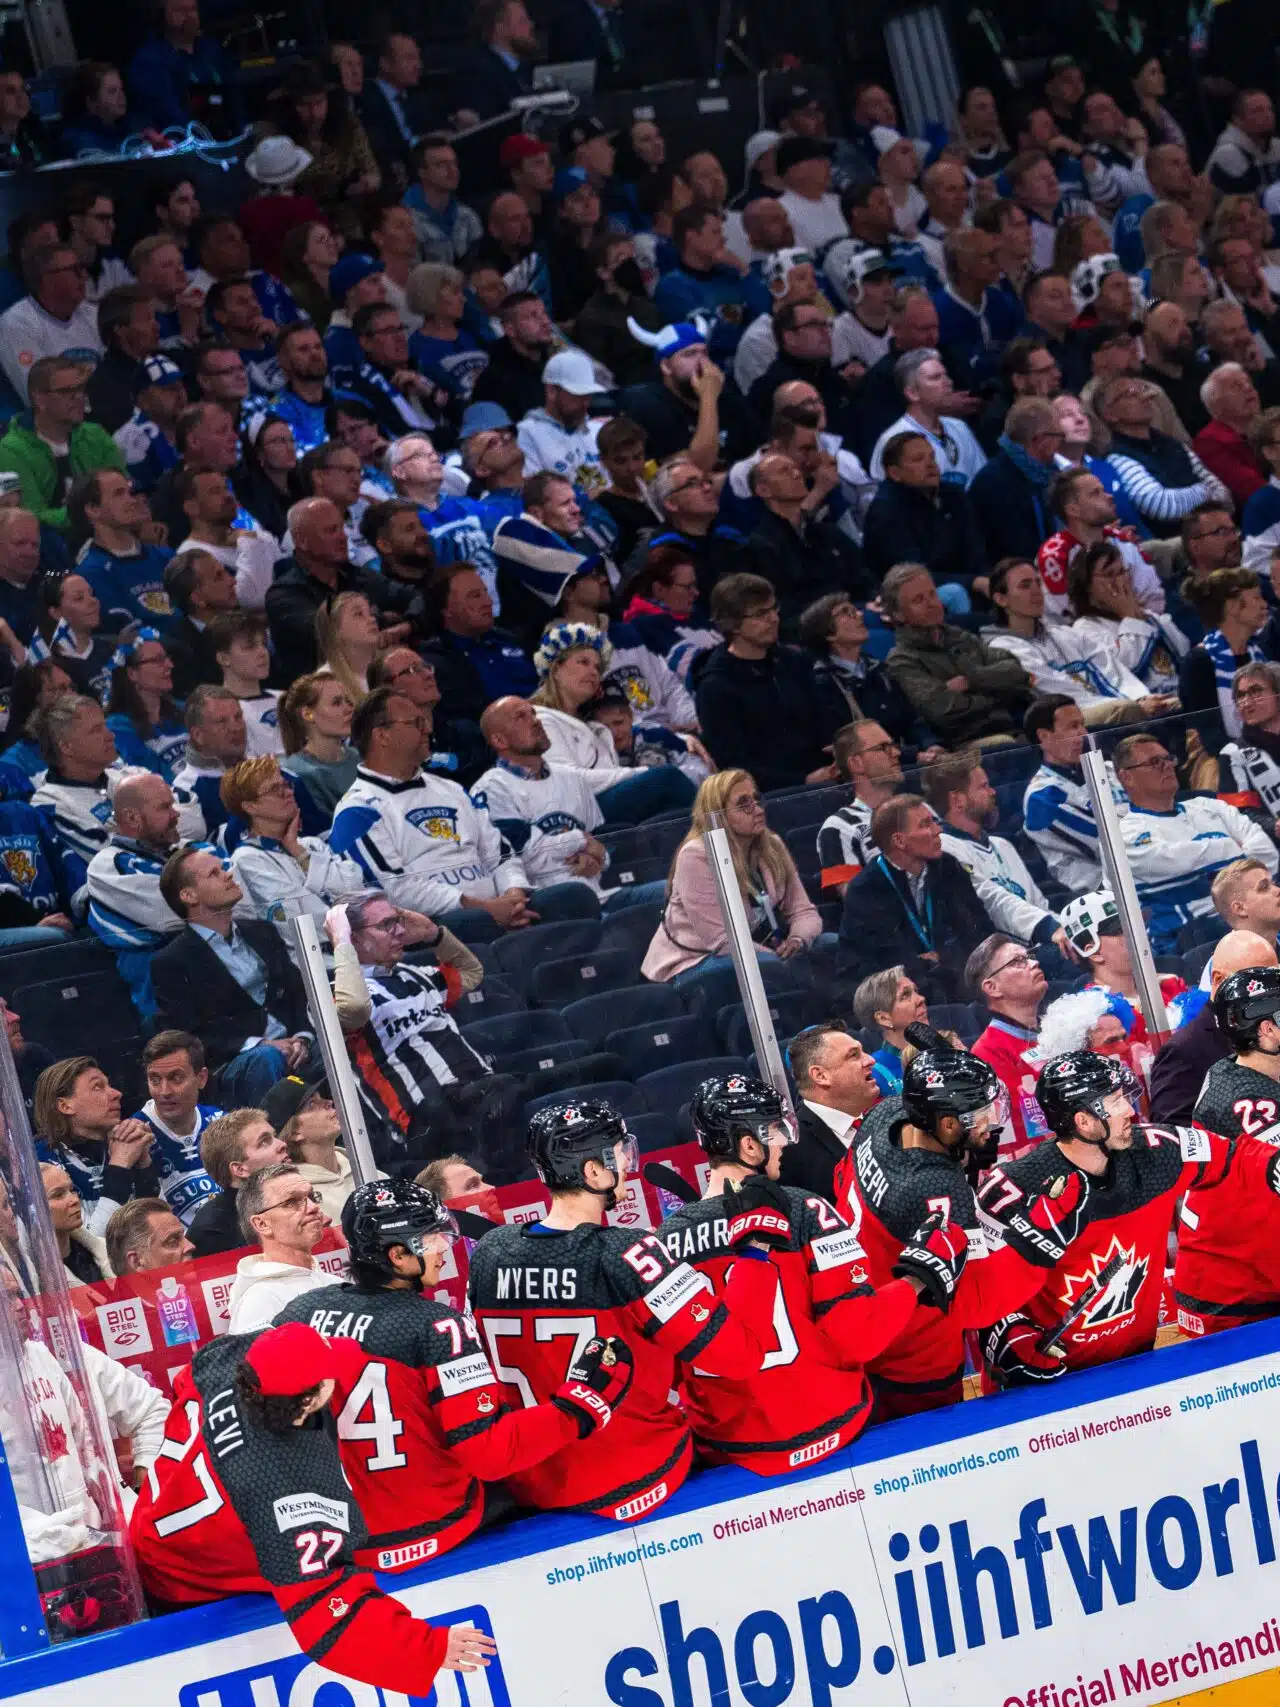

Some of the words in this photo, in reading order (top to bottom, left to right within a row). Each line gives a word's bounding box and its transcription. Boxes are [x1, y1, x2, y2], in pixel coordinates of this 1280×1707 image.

[856, 1134, 890, 1208] JOSEPH
[613, 1202, 638, 1213] STEEL
[1009, 1213, 1065, 1260] BAUER
[622, 1235, 677, 1283] 57
[899, 1246, 954, 1294] BAUER
[496, 1267, 578, 1300] MYERS
[106, 1306, 137, 1326] BIO
[162, 1298, 188, 1316] BIO
[309, 1309, 373, 1343] BEAR
[109, 1322, 138, 1334] STEEL
[985, 1312, 1030, 1365] BAUER
[1071, 1313, 1137, 1343] CANADA
[206, 1388, 245, 1458] LEVI
[1028, 1428, 1081, 1455] Official
[1081, 1403, 1173, 1441] Merchandise
[799, 1434, 838, 1462] IIHF
[872, 1443, 1020, 1497] shop.iihfworlds.com
[276, 1499, 345, 1520] WESTMINSTER
[628, 1486, 666, 1515] IIHF
[712, 1510, 769, 1541] Official
[769, 1486, 866, 1526] Merchandise
[295, 1529, 344, 1575] 27
[394, 1540, 434, 1565] IIHF
[545, 1531, 704, 1586] shop.iihfworlds.com
